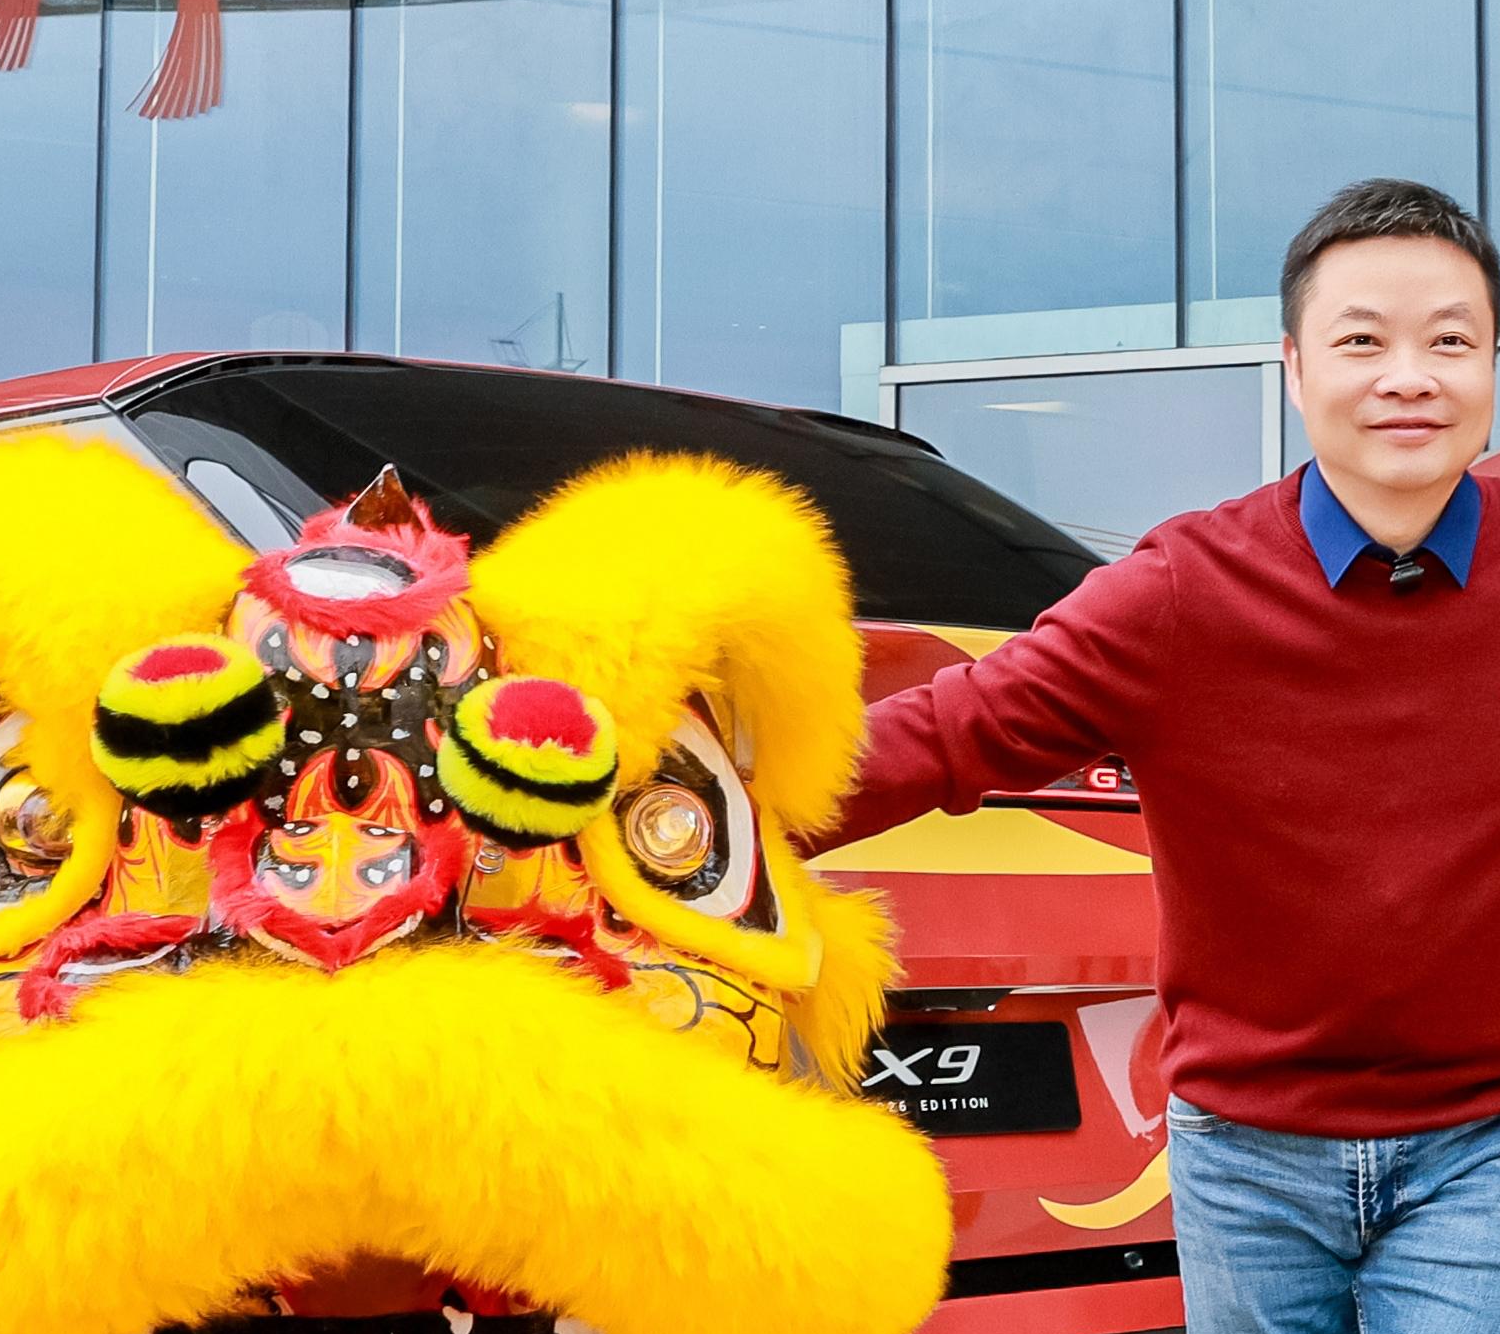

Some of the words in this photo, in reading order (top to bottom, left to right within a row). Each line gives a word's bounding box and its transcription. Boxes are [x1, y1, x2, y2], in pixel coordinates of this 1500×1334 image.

[861, 1045, 981, 1087] X9
[876, 1100, 907, 1113] 26
[920, 1097, 989, 1112] EDITION
